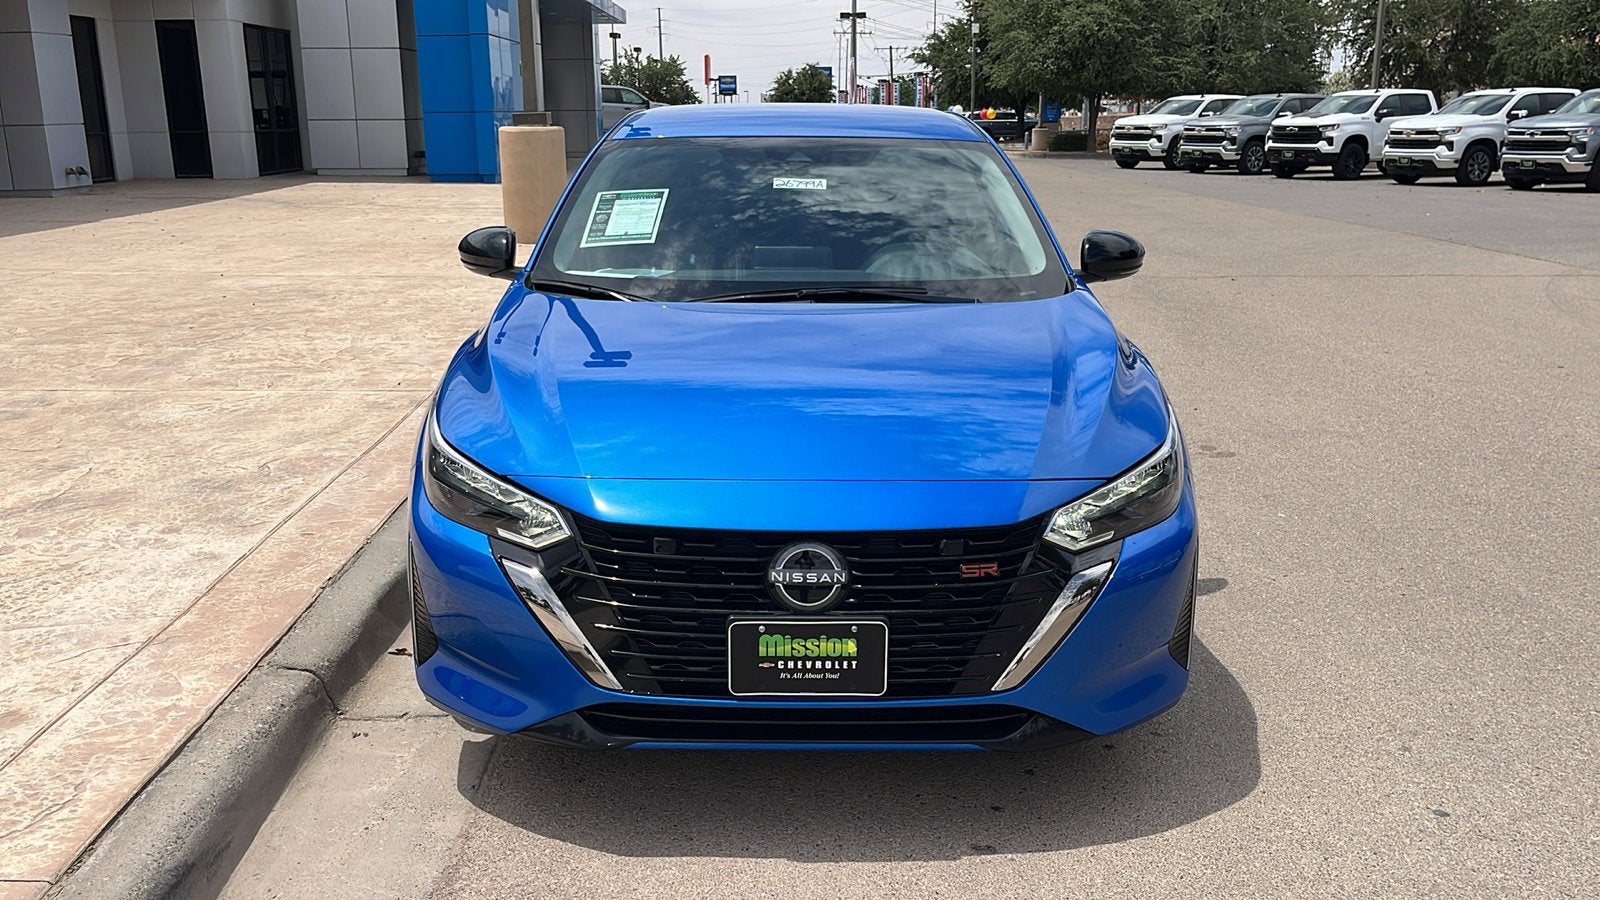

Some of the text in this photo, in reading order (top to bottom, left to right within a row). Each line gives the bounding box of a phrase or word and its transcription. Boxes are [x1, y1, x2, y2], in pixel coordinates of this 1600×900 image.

[961, 562, 999, 577] SR
[771, 571, 847, 583] NISSAN
[758, 634, 858, 657] Mission
[777, 660, 858, 669] CHEVROLET
